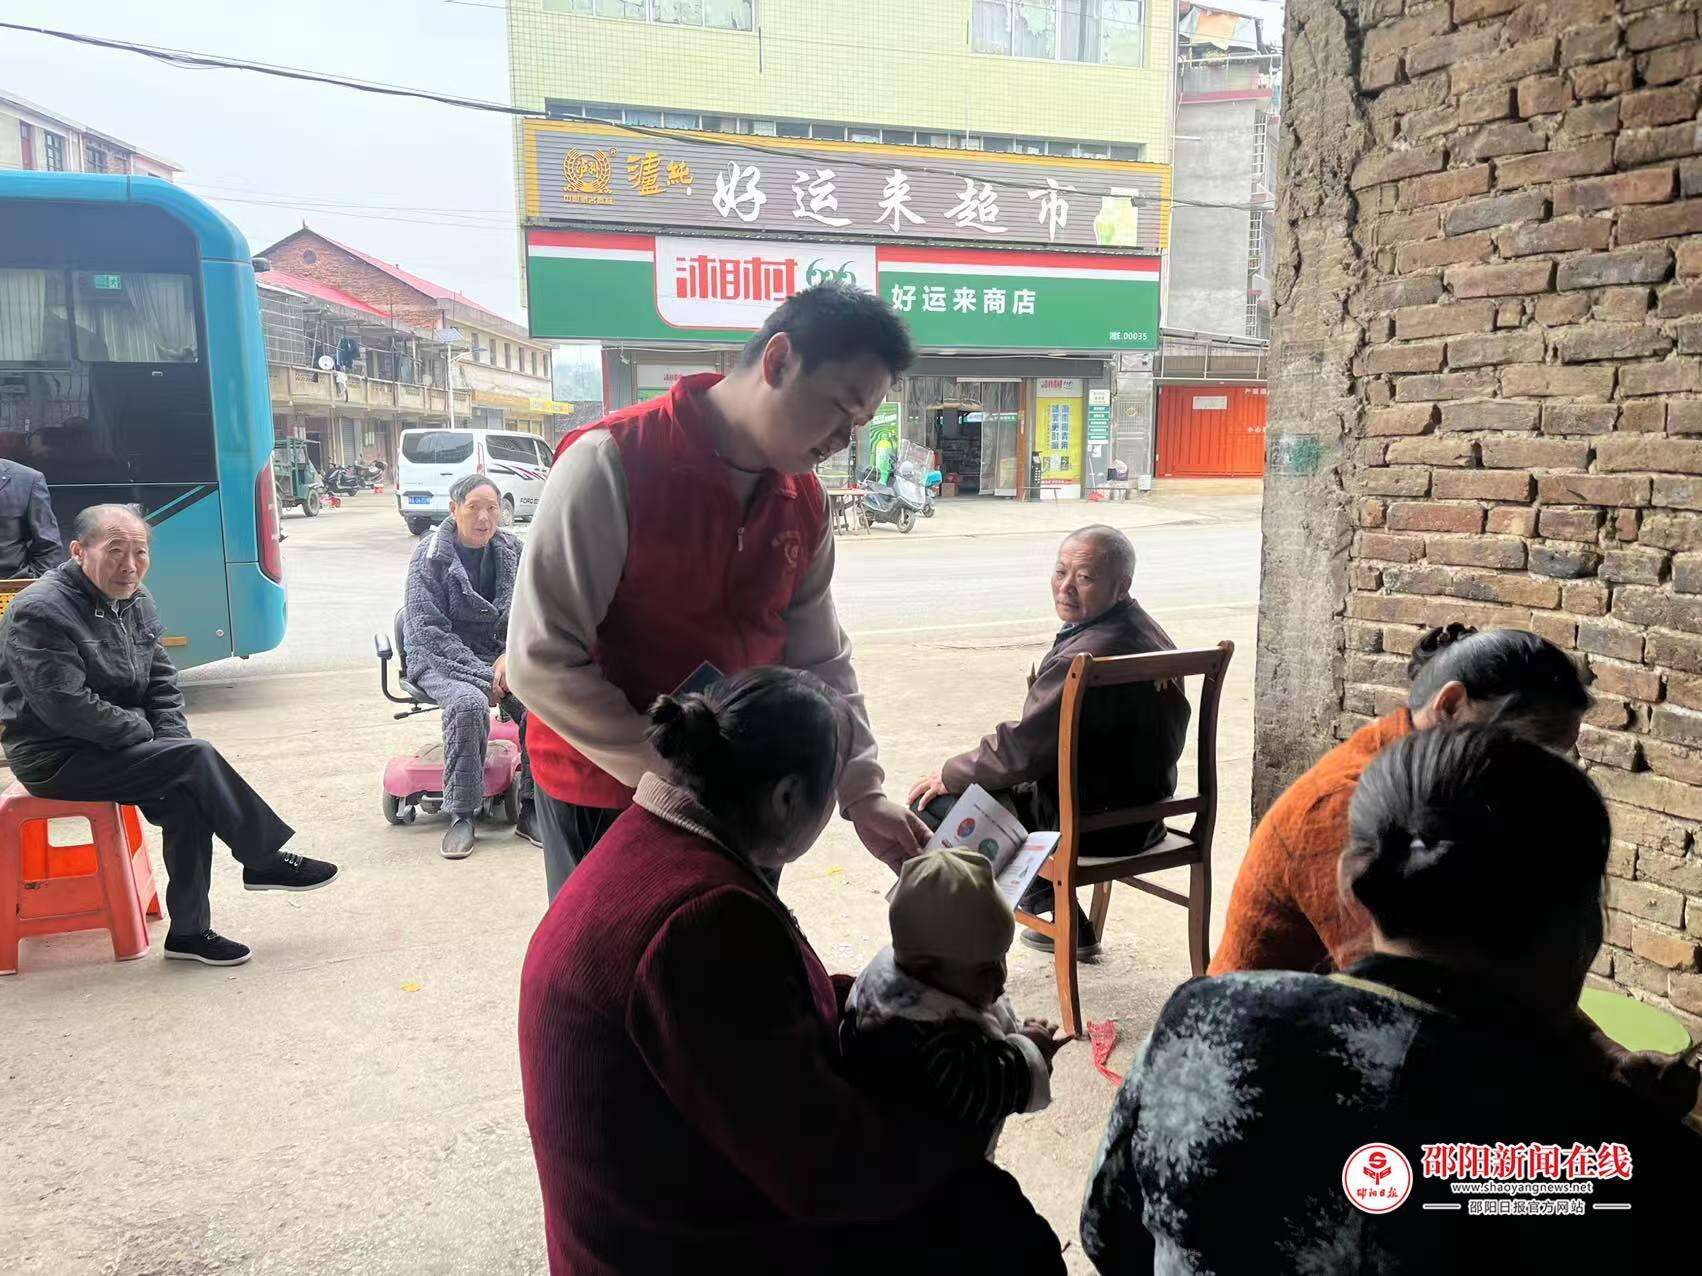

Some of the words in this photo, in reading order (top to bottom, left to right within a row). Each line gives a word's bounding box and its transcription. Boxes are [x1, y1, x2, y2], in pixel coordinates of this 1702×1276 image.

[712, 160, 1077, 242] 好运来超市
[891, 284, 1037, 315] 好运来商店
